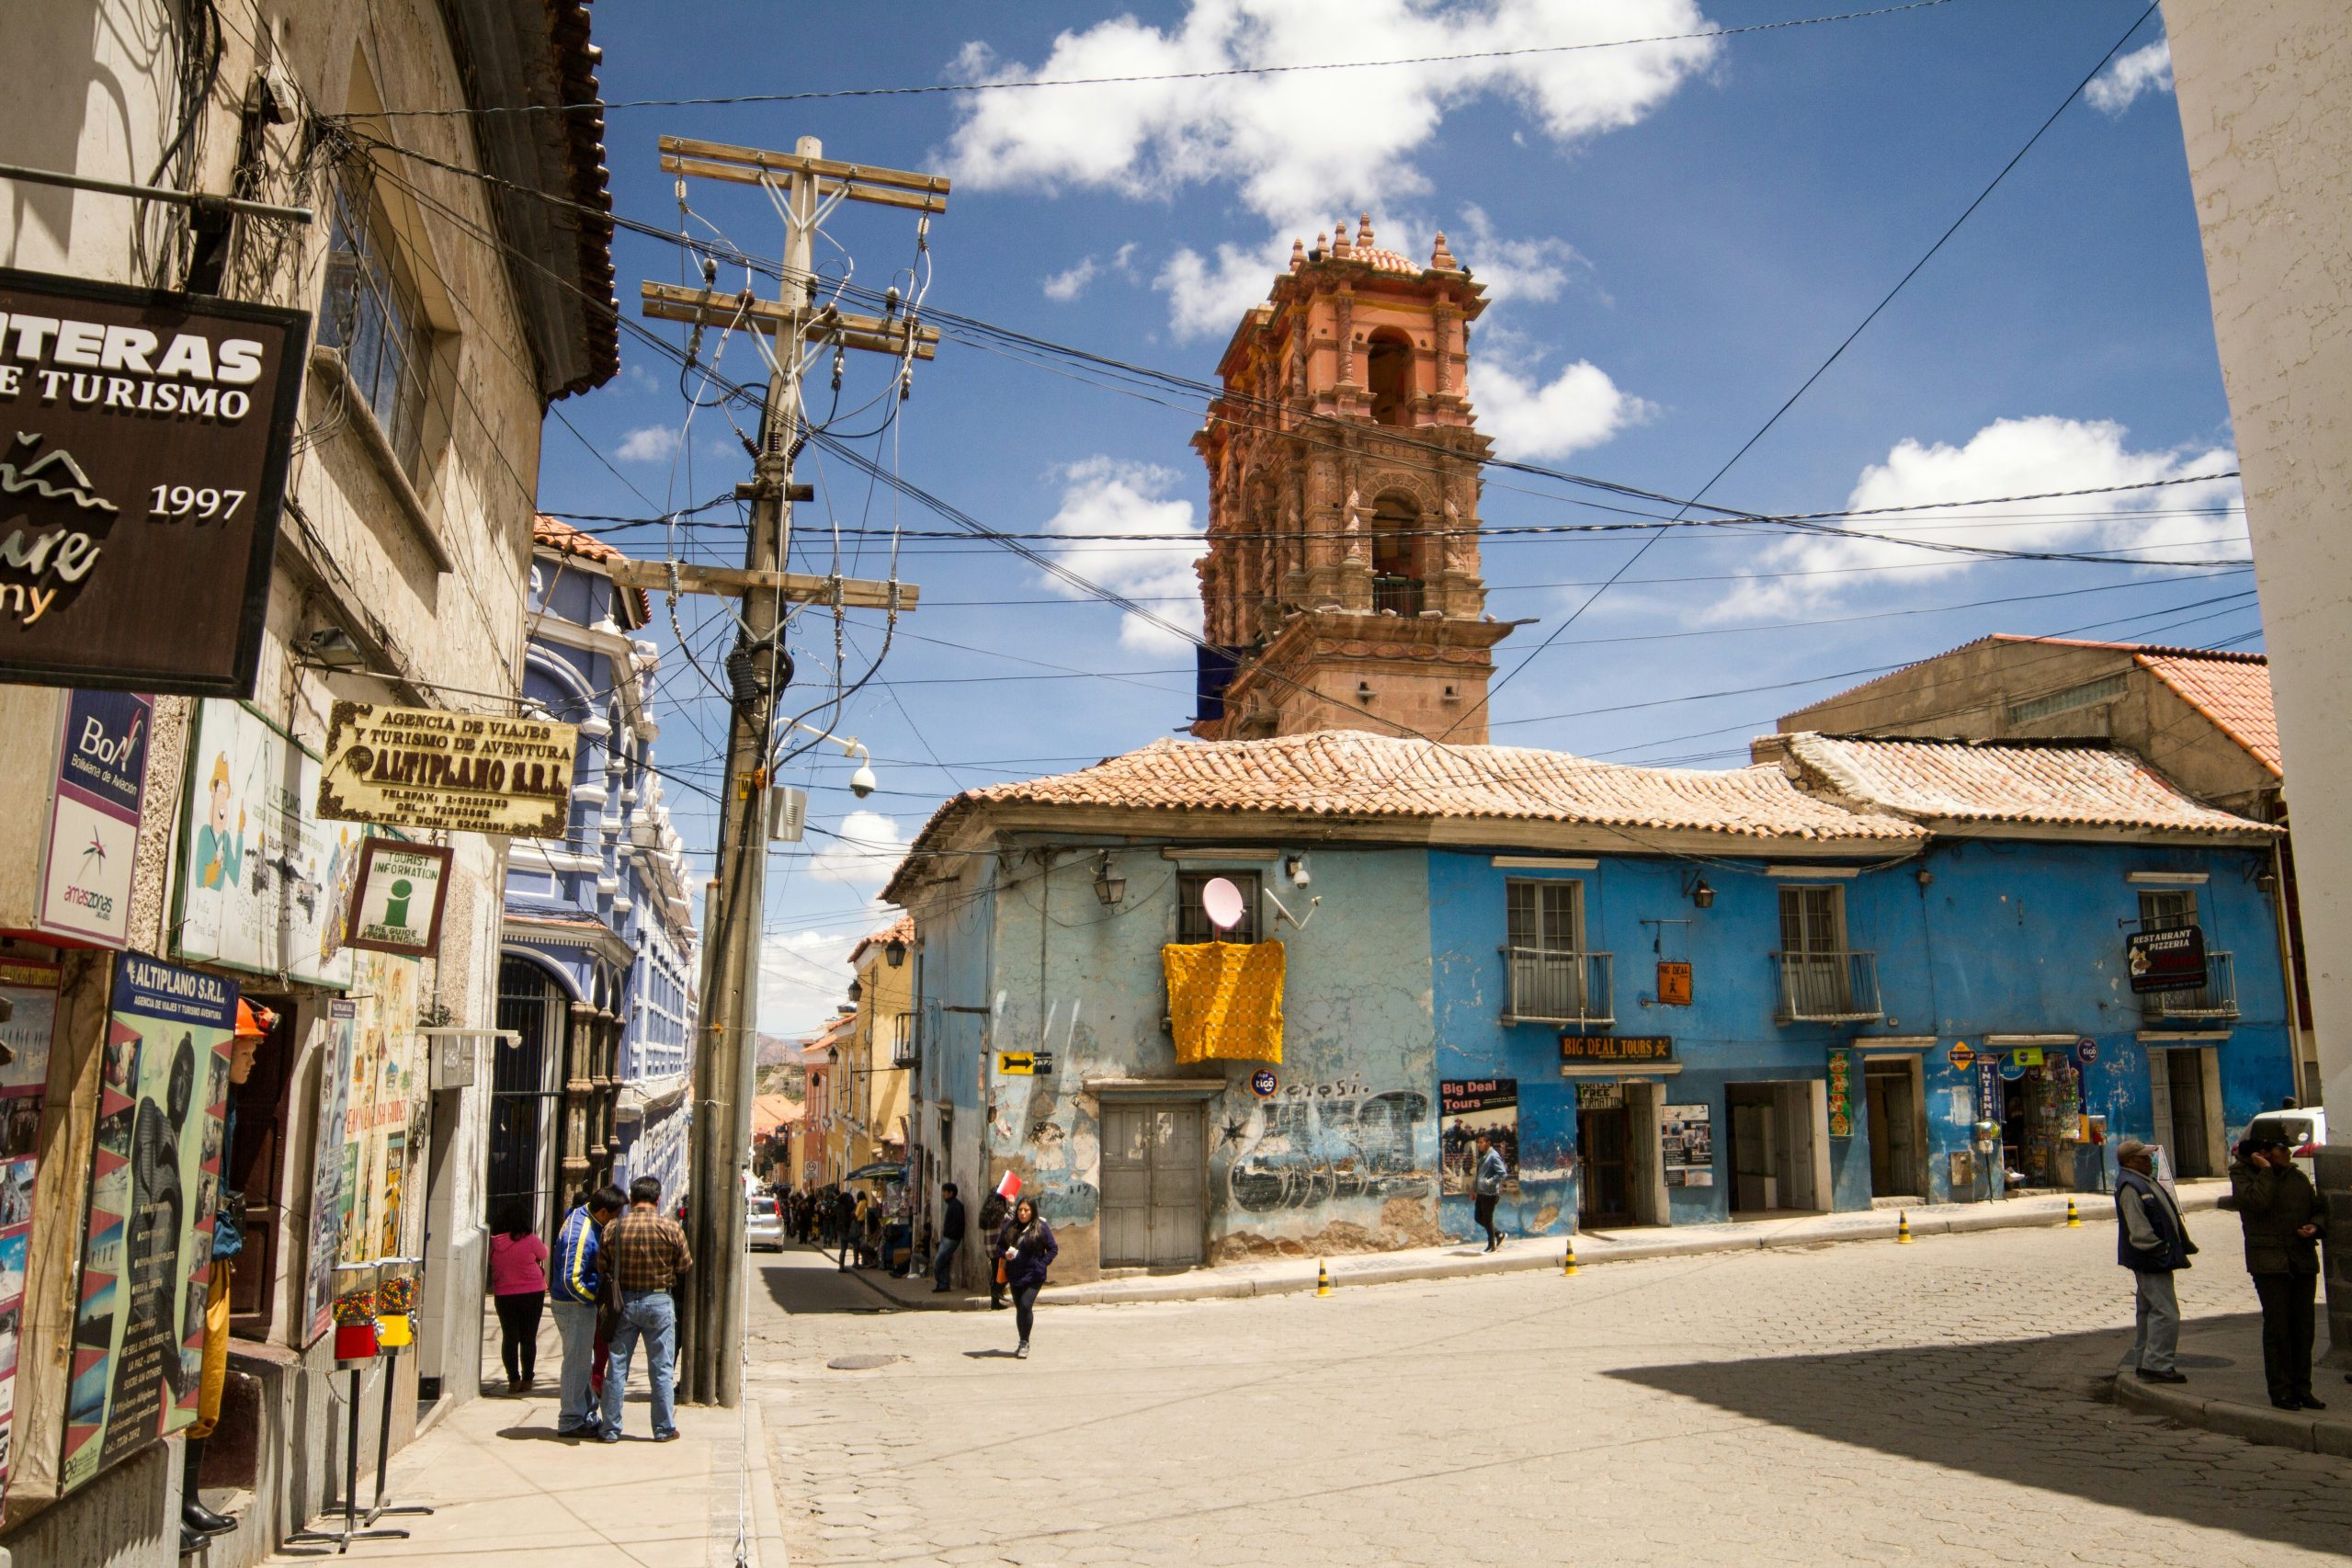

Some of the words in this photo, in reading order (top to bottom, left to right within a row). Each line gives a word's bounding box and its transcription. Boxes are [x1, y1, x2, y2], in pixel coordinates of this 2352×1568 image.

[0, 312, 263, 384] TERAS
[39, 369, 250, 419] TURISMO
[149, 484, 246, 520] 1997
[381, 711, 456, 732] AGENCIA
[460, 720, 483, 734] DE
[489, 722, 551, 739] VIAJES
[354, 727, 366, 741] Y
[370, 730, 449, 749] TURISMO
[453, 738, 475, 751] DE
[481, 741, 571, 760] AVENTURA
[71, 754, 101, 778] Boliviana
[102, 770, 111, 782] de
[372, 749, 506, 791] ALTIPLANO
[512, 761, 568, 797] S.R.L.
[381, 790, 437, 802] TELEFAX:
[374, 862, 437, 880] INFORMATION
[389, 852, 430, 867] TOURIST
[64, 885, 112, 913] amaszonas
[2133, 929, 2191, 944] RESTAURANT
[2149, 939, 2189, 950] PIZZERIA
[135, 963, 196, 997] ALTIPLANO
[198, 977, 225, 1004] S.R.L.
[133, 995, 153, 1007] AGENCIA
[154, 999, 162, 1009] DE
[162, 1001, 177, 1012] VIAJES
[177, 1004, 181, 1013] Y
[182, 1005, 200, 1017] TURISMO
[200, 1008, 222, 1020] AVENTURA
[1563, 1038, 1584, 1055] BIG
[1587, 1038, 1617, 1055] DEAL
[1621, 1040, 1653, 1055] TOURS
[1442, 1083, 1464, 1096] Big
[1467, 1080, 1496, 1093] Deal
[1583, 1088, 1610, 1096] FREE
[1982, 1065, 1993, 1119] INTERNE
[1443, 1098, 1481, 1110] Tours
